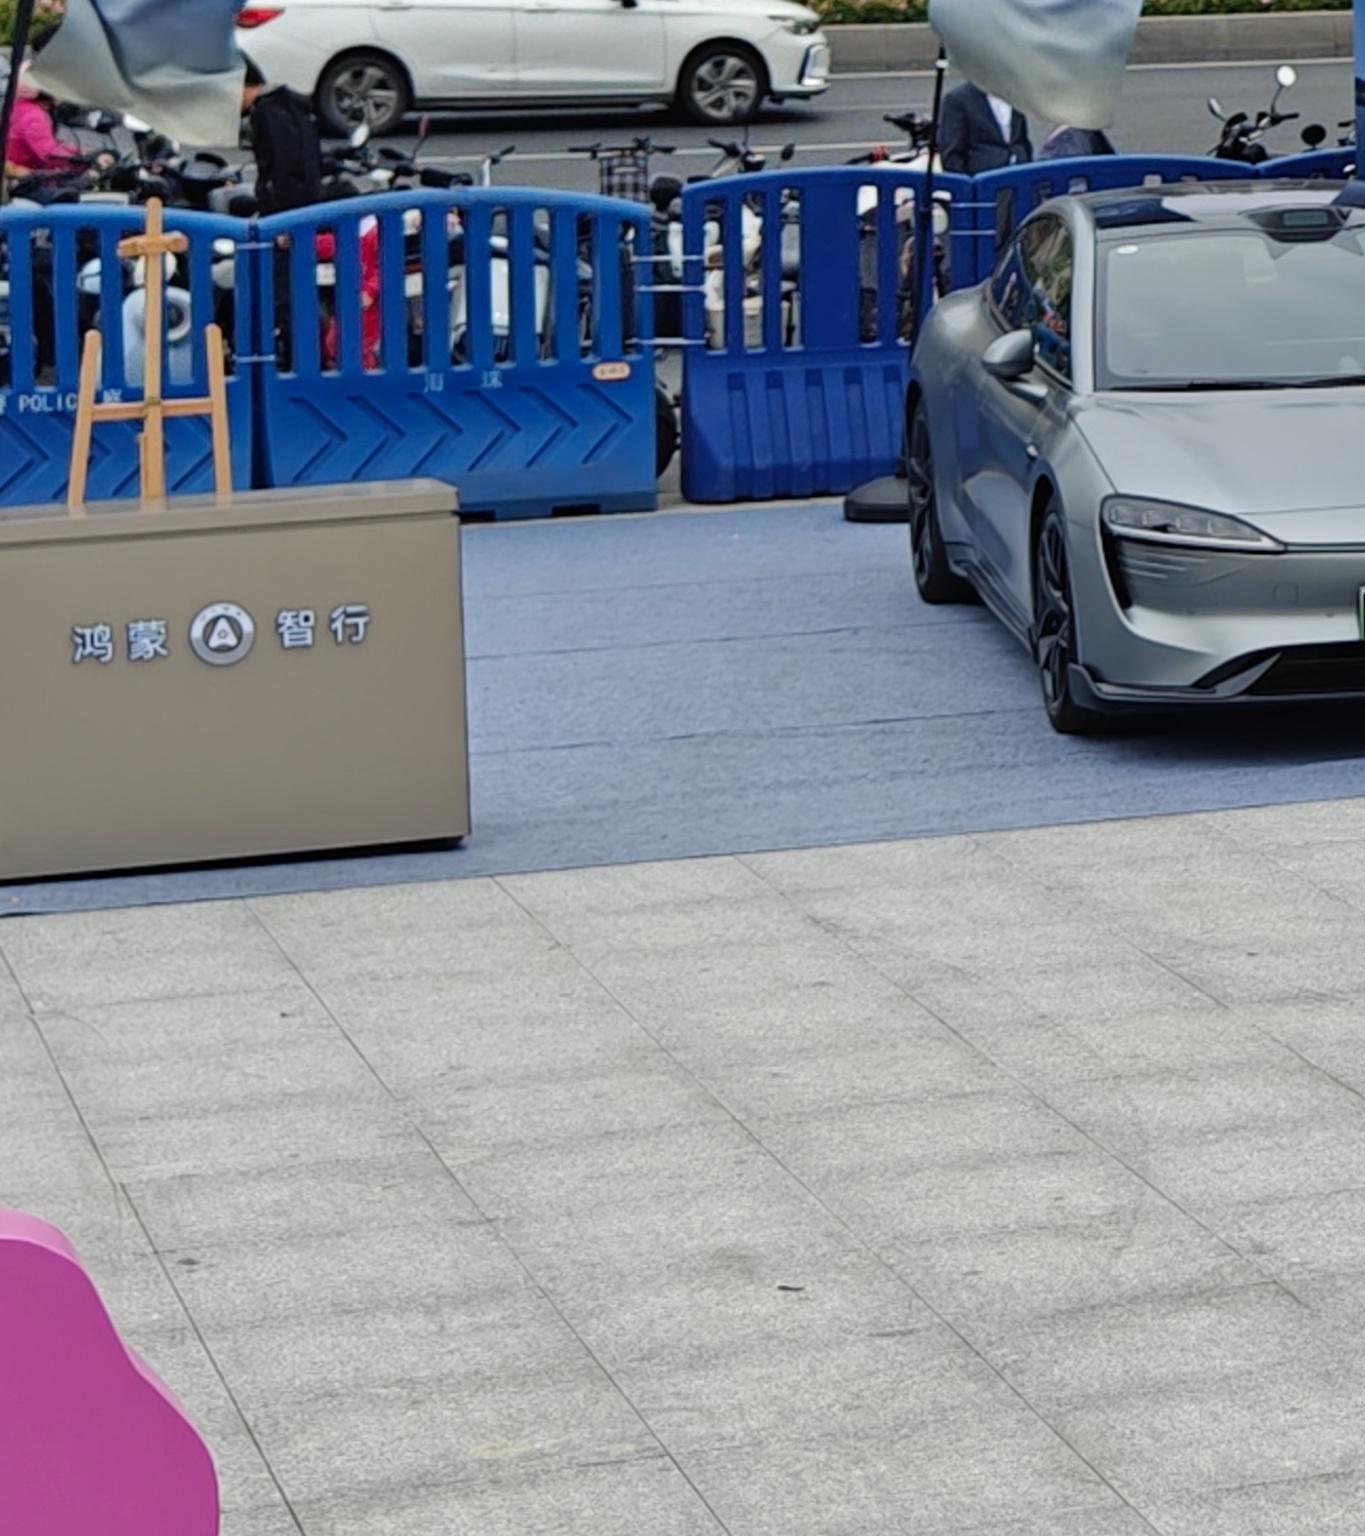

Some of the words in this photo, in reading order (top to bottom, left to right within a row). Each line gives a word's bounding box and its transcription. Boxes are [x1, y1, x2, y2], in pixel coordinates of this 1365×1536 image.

[18, 392, 78, 413] POLIC
[72, 619, 169, 663] 鸿蒙
[276, 604, 370, 648] 智行
